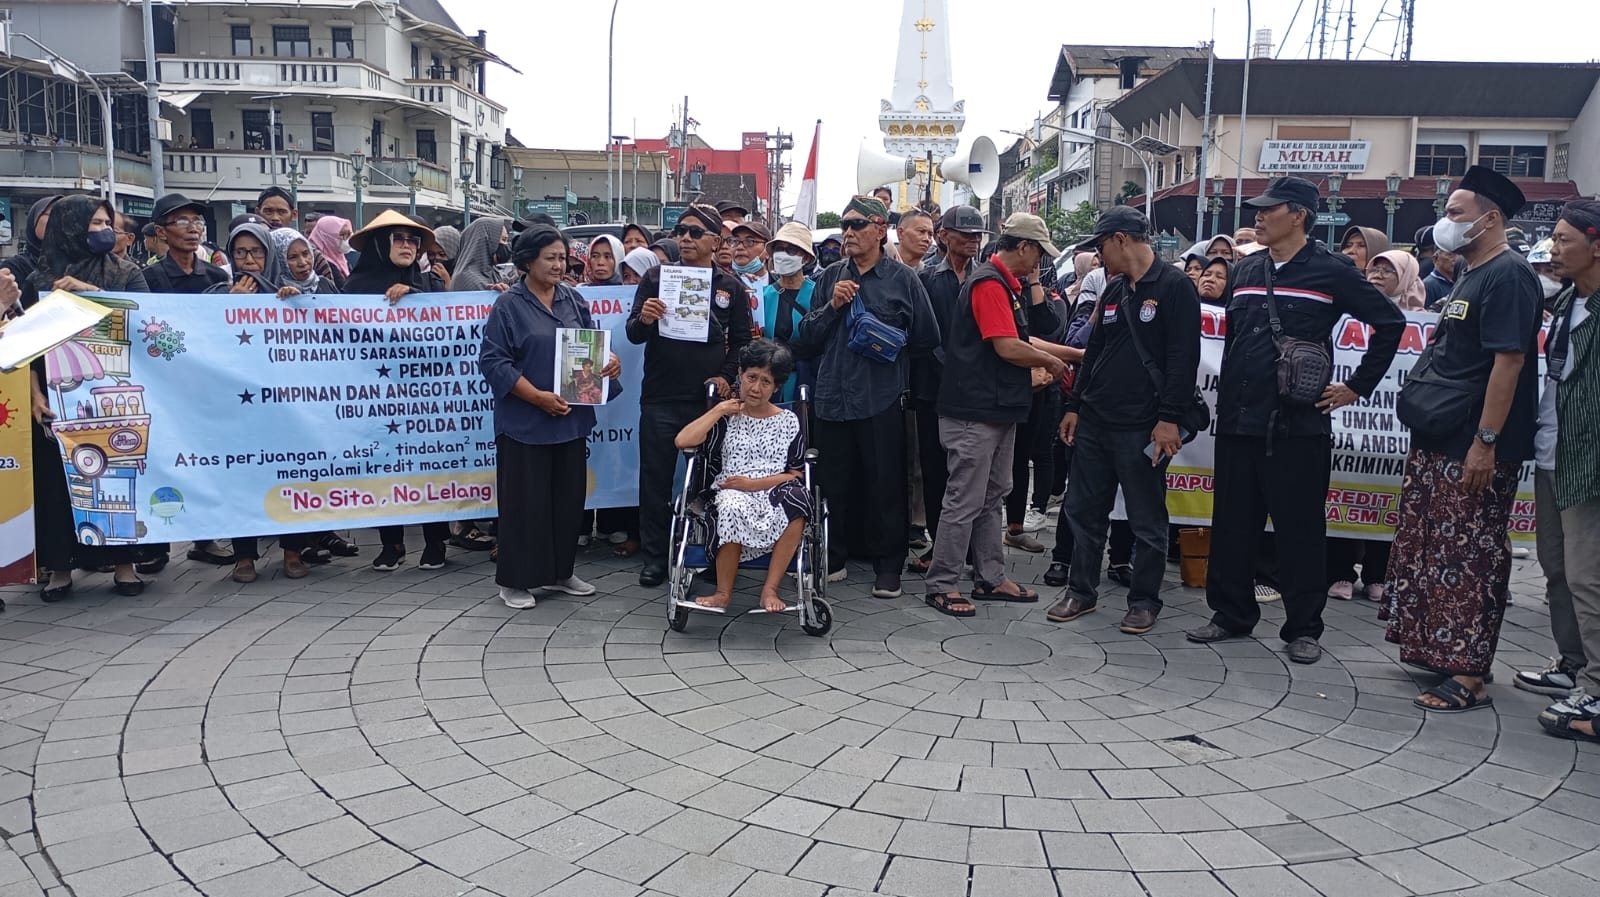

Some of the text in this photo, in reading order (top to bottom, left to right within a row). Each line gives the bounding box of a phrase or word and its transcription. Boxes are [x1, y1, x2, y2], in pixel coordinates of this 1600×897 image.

[1278, 150, 1352, 162] MURAH
[225, 308, 278, 324] UMKM
[283, 307, 308, 324] DIY
[314, 306, 442, 323] MENGUCAPKAN
[446, 304, 492, 321] TERIM
[591, 299, 622, 314] ADA
[264, 328, 344, 345] PIMPINAN
[349, 327, 384, 344] DAN
[389, 325, 466, 342] ANGGOTA
[268, 344, 480, 363] (IBU RAHAYU SARASWATI D DJO
[400, 362, 455, 378] PEMDA
[262, 380, 492, 403] PIMPINAN DAN ANGGOTA KO
[335, 403, 364, 420] (IBU
[368, 401, 440, 418] ANDRIANA
[1342, 410, 1393, 431] UMKM
[406, 416, 483, 433] POLDA DIY
[174, 451, 220, 467] Atas
[475, 441, 496, 451] me
[608, 428, 633, 442] DIY
[1360, 434, 1408, 455] AMBU
[277, 454, 496, 482] mengalami kredit macet aki
[1332, 454, 1404, 476] KRIMINA
[330, 488, 375, 507] Sita
[394, 486, 420, 502] No
[427, 483, 492, 501] Lelang
[1327, 489, 1394, 508] REDIT
